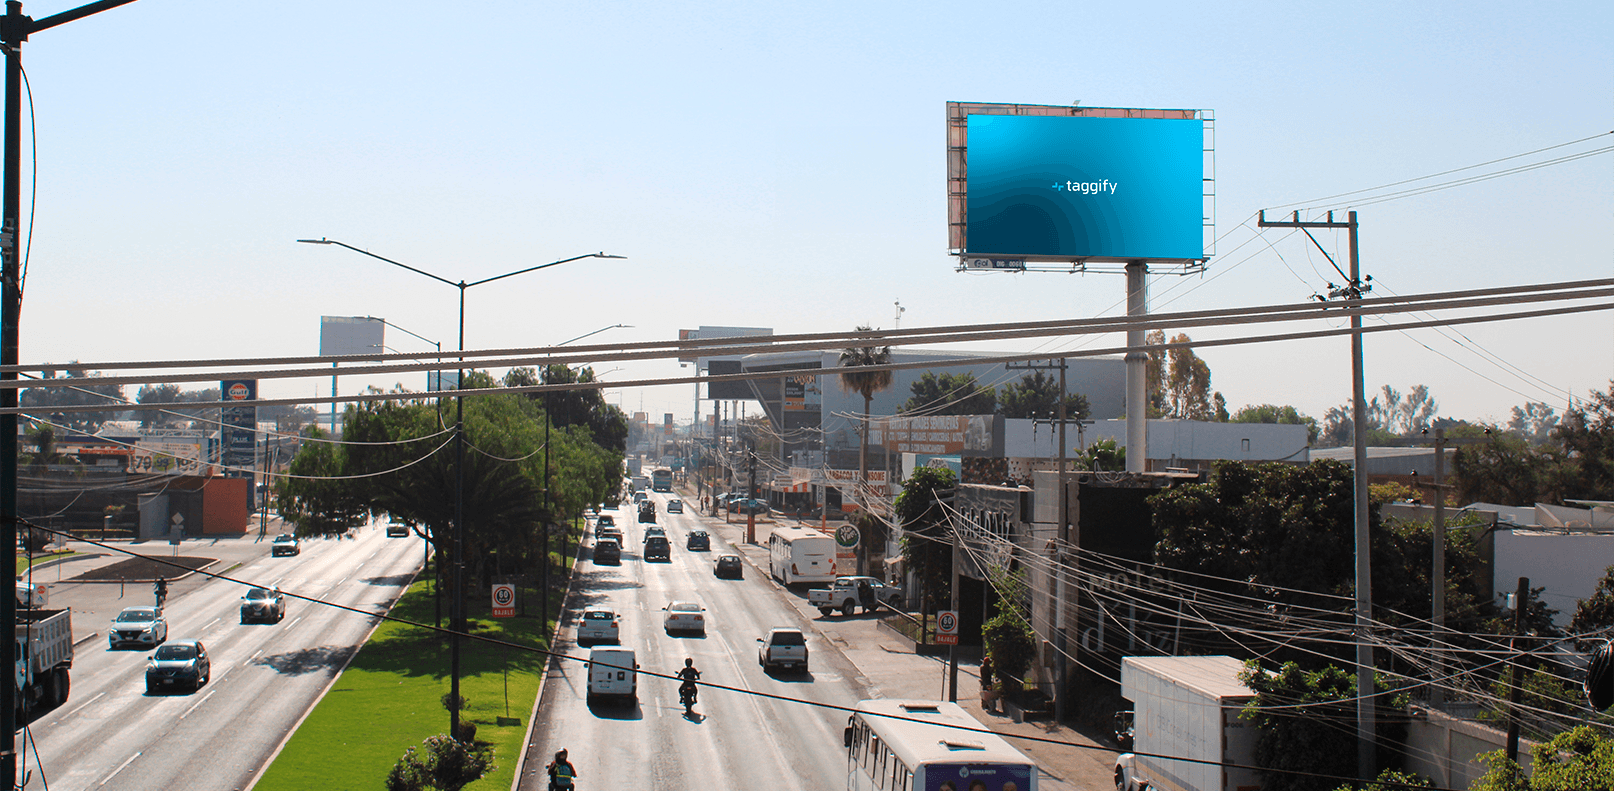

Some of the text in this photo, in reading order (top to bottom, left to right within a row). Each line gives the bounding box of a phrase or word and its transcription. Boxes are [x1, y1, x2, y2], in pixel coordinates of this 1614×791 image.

[1066, 179, 1118, 195] taggify
[499, 590, 509, 599] 60
[943, 616, 952, 625] 60
